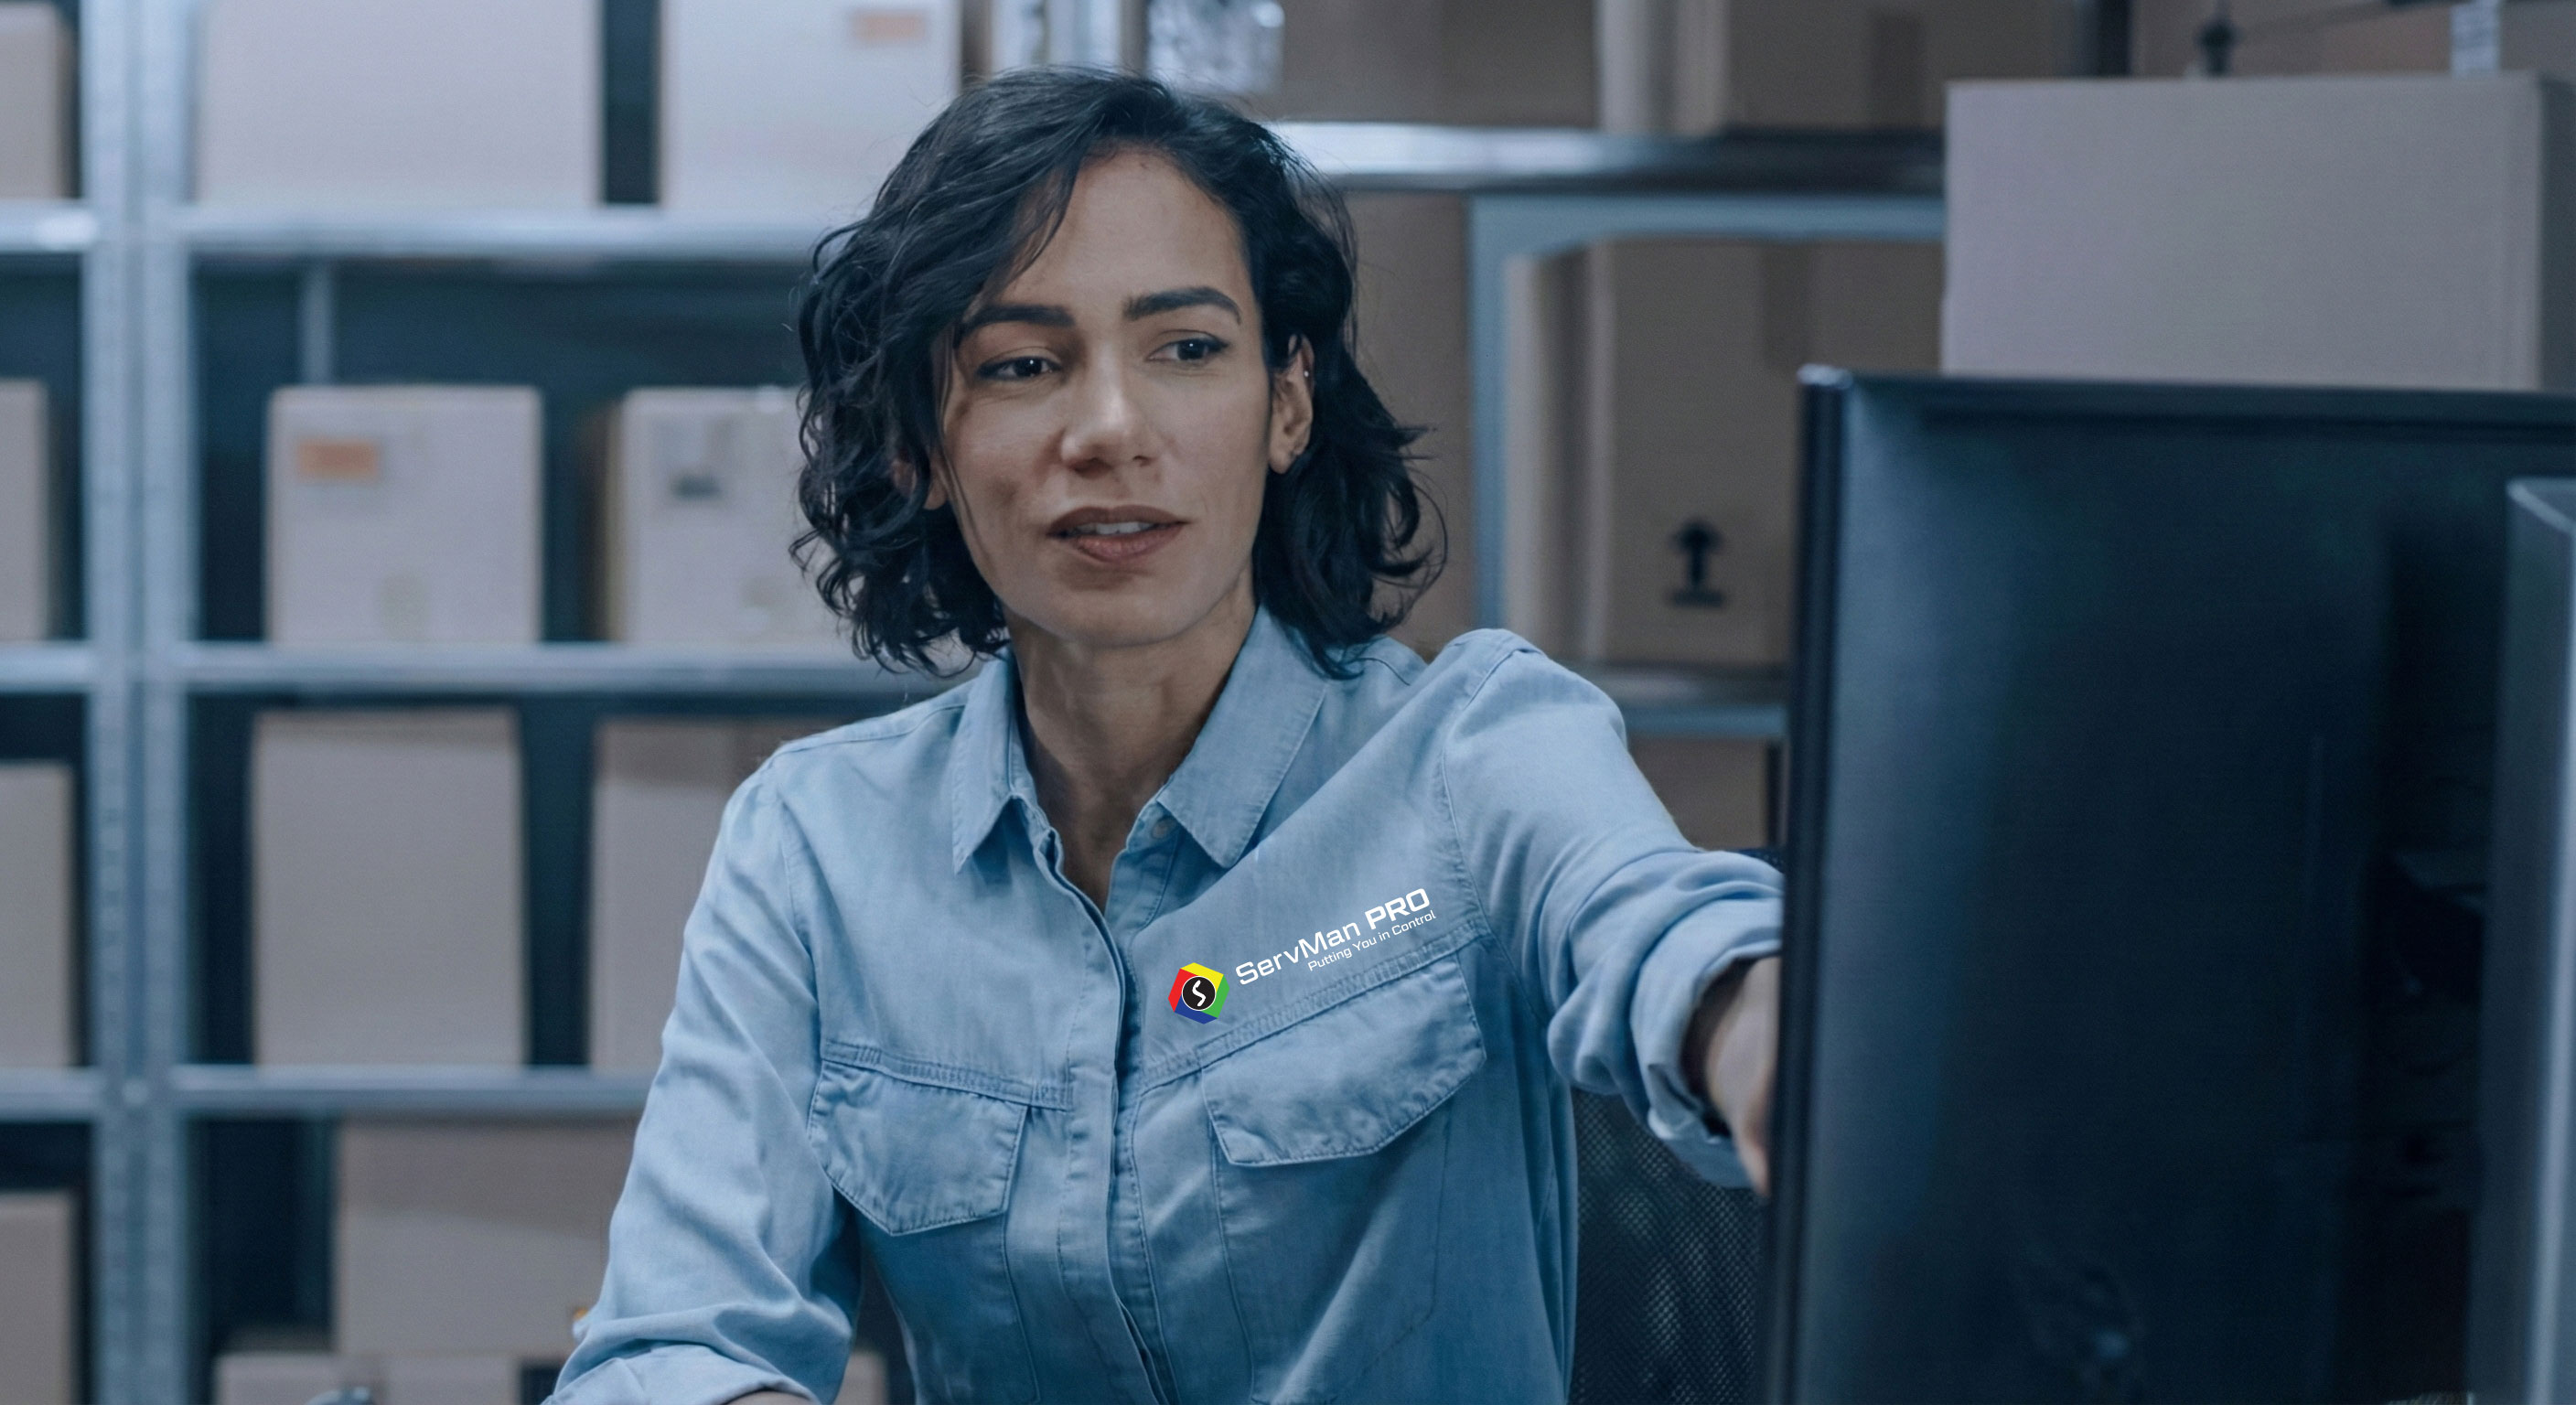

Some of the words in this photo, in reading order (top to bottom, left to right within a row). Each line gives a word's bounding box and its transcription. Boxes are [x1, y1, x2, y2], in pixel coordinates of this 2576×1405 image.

[1235, 922, 1361, 985] ServMan
[1364, 888, 1431, 930] PRO
[1307, 948, 1353, 971] Putting
[1352, 937, 1378, 952] You
[1379, 930, 1391, 941] in
[1391, 909, 1436, 936] Control
